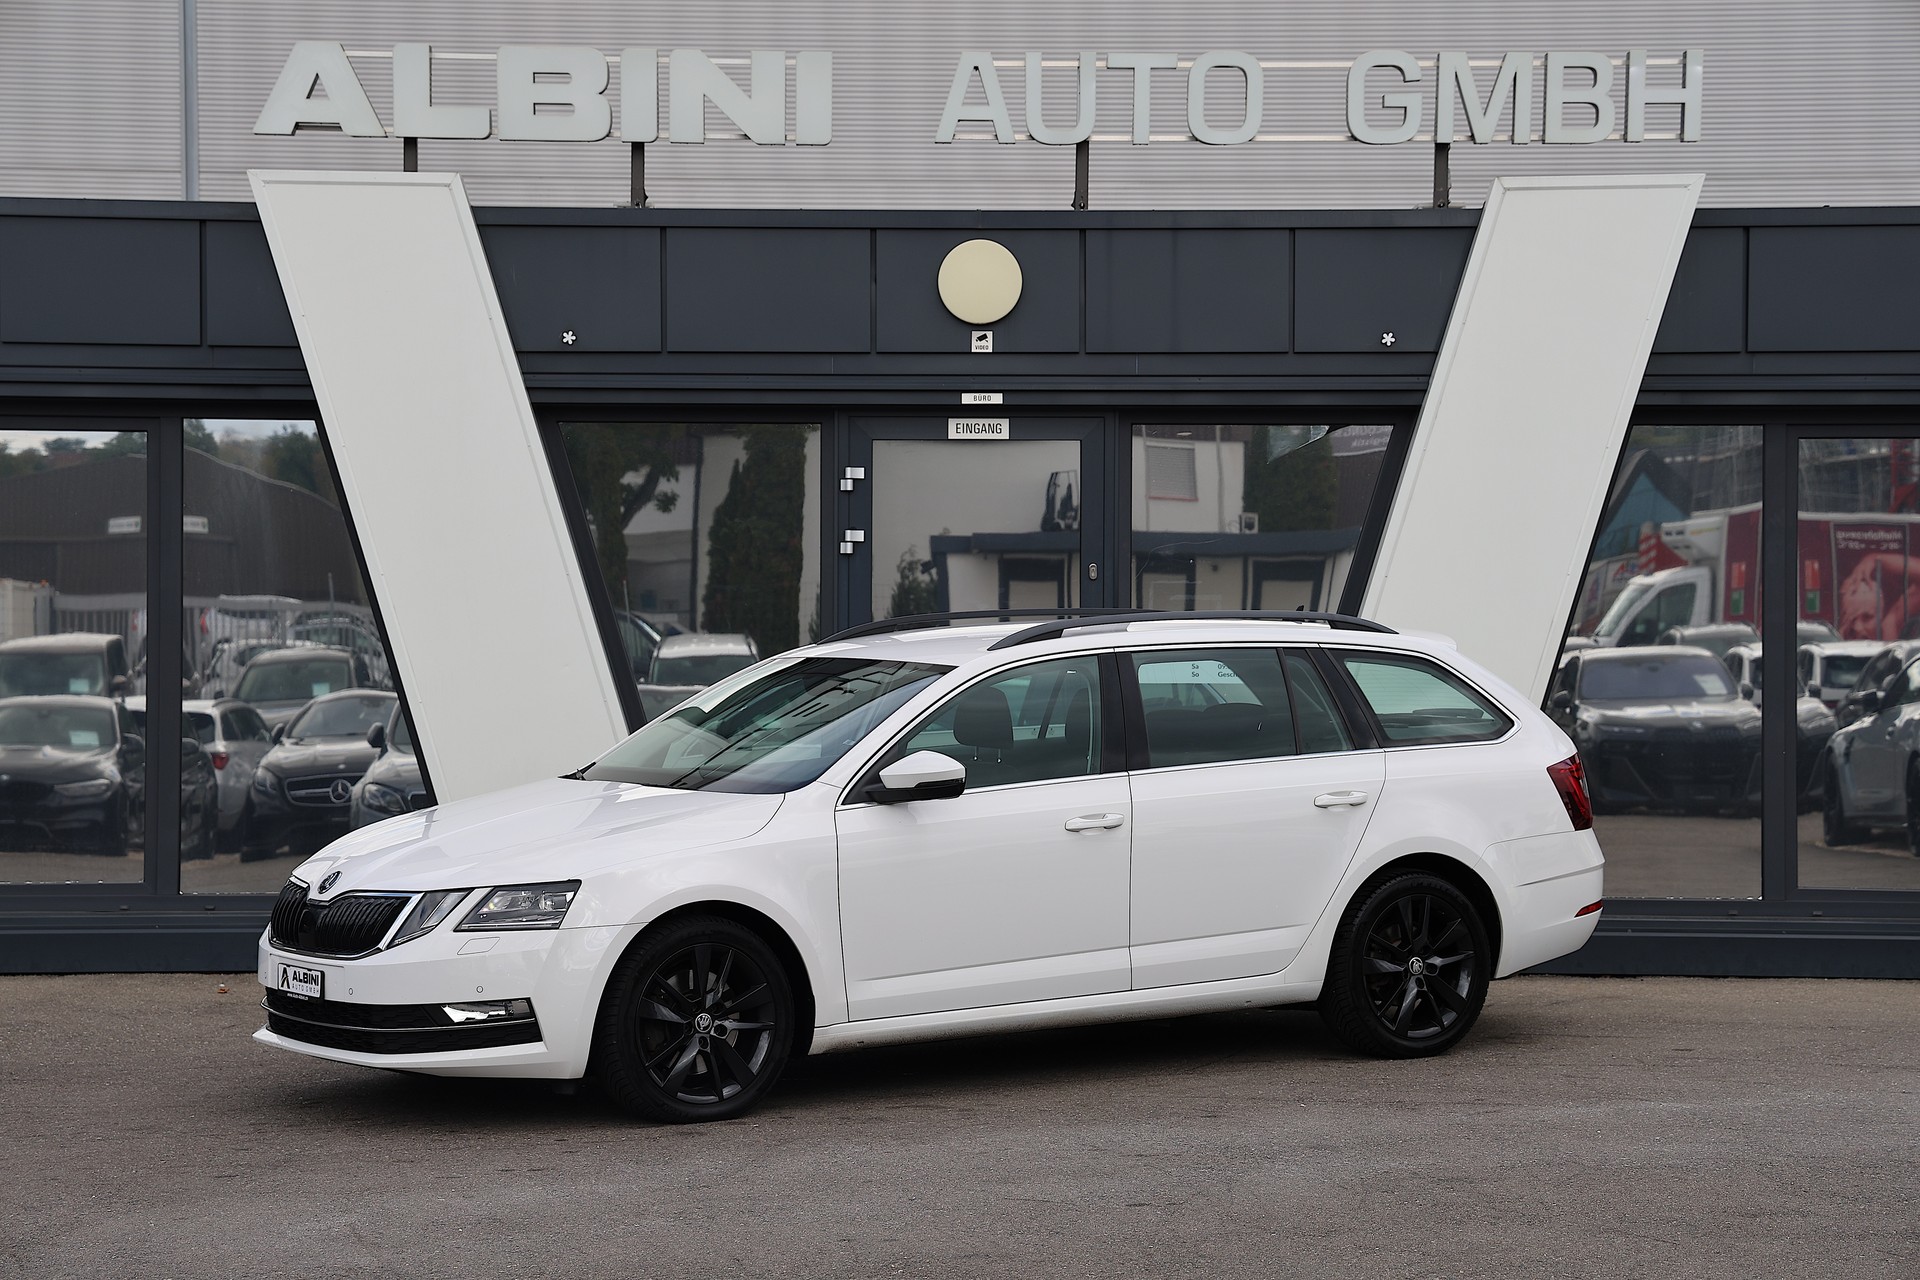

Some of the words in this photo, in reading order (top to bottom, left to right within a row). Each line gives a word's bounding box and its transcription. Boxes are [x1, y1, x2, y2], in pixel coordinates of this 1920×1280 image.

[253, 41, 833, 146] ALBINI
[934, 50, 1265, 146] AUTO
[1346, 49, 1704, 146] GMBH
[973, 394, 992, 402] BÜRO
[955, 423, 1003, 434] EINGANG
[292, 970, 319, 987] ALBINI
[292, 983, 304, 992] AUTO
